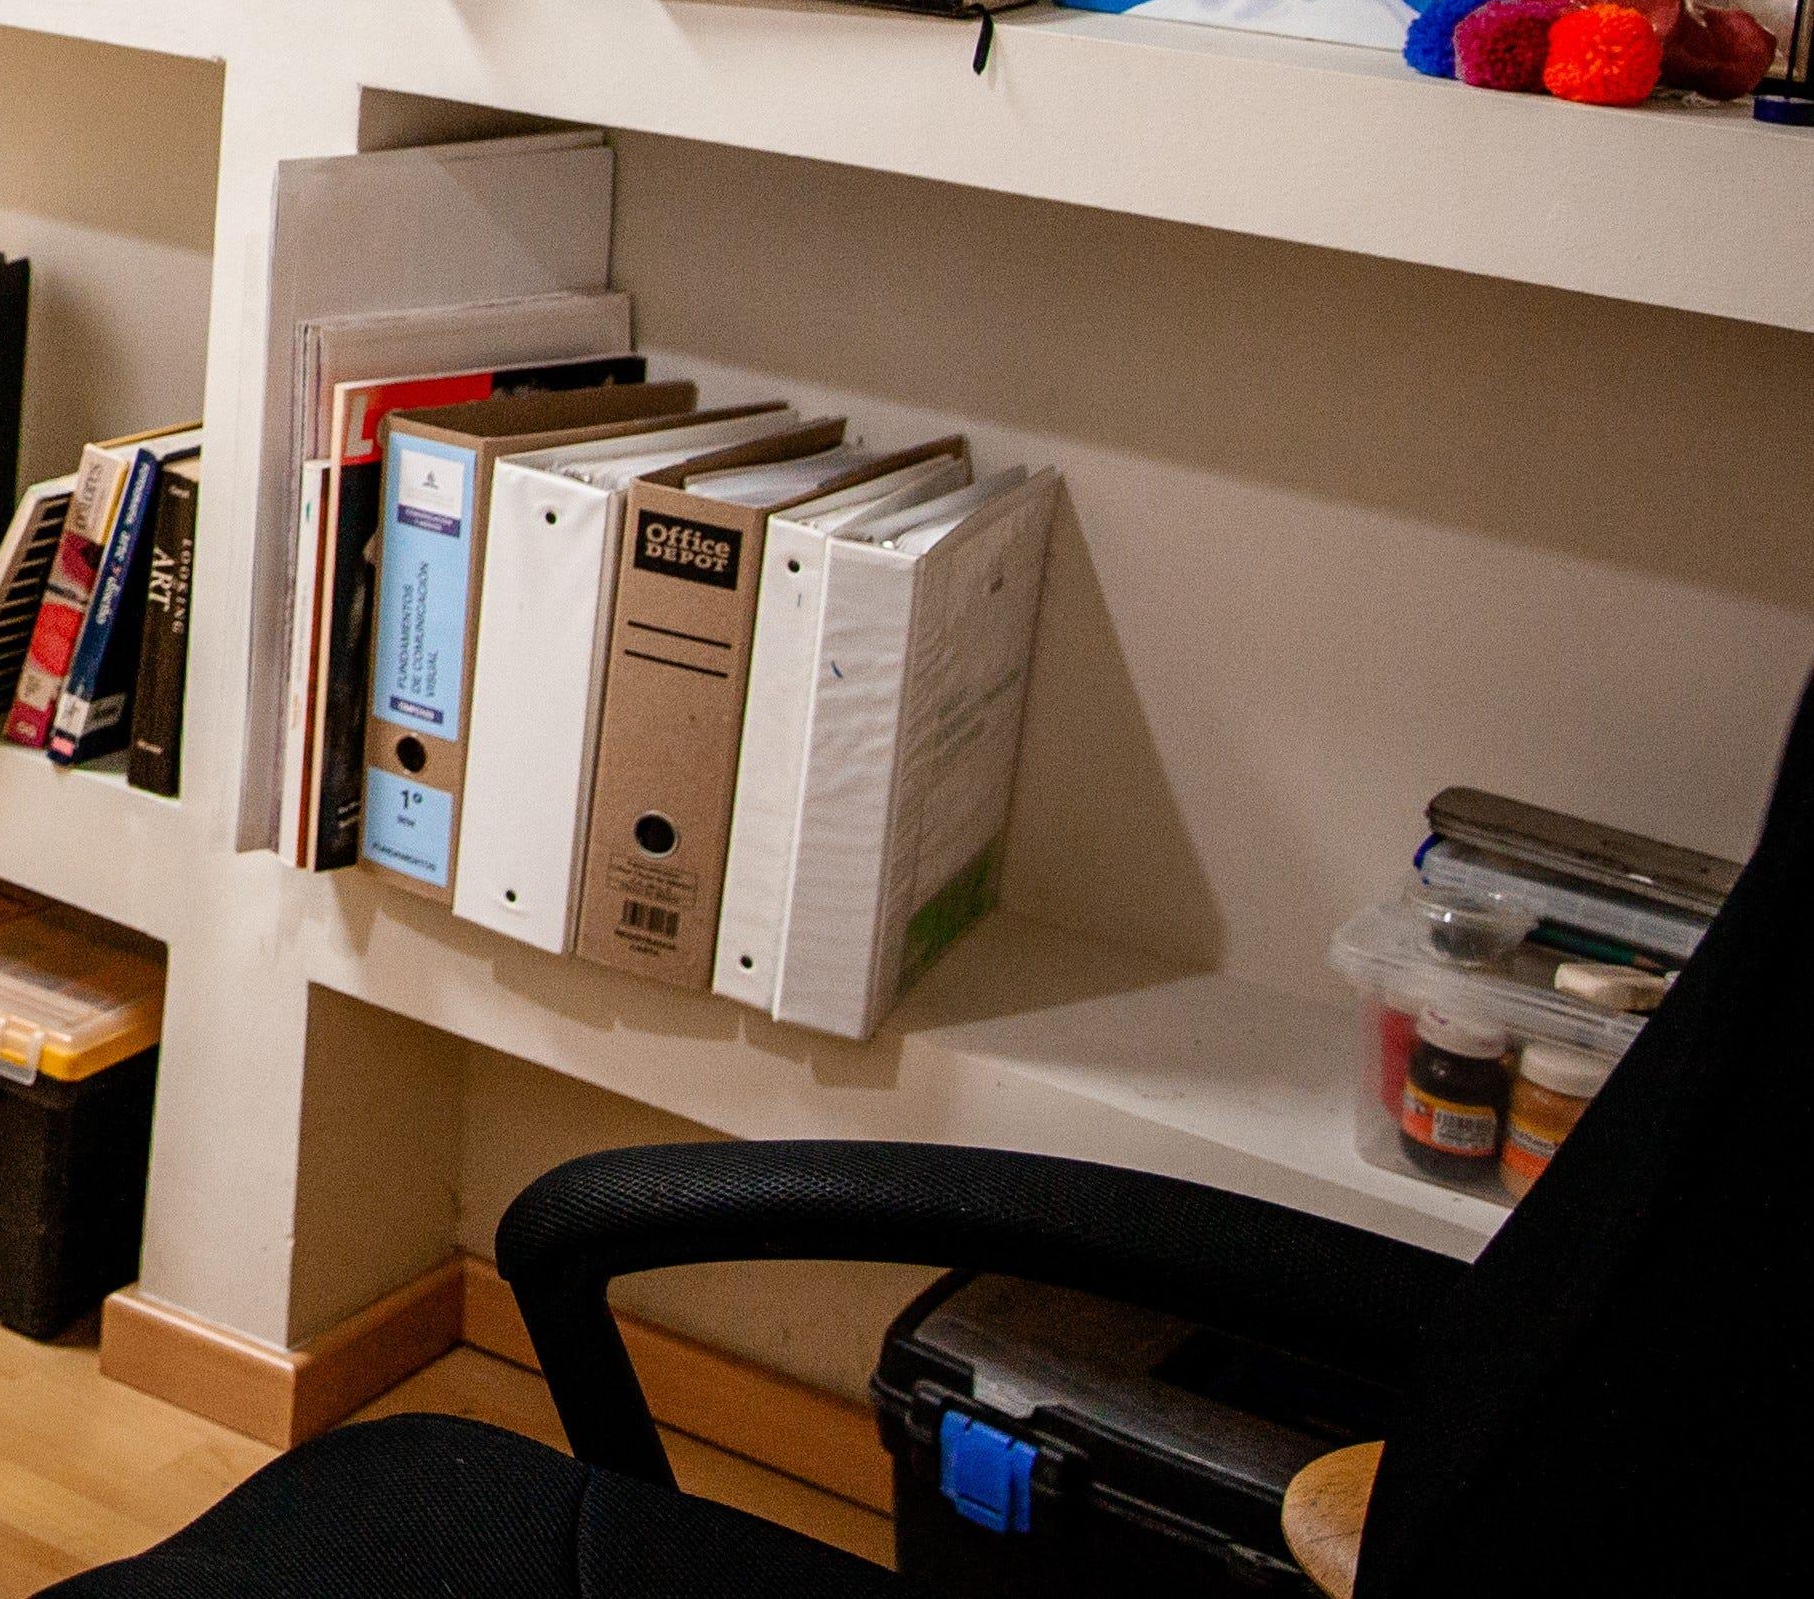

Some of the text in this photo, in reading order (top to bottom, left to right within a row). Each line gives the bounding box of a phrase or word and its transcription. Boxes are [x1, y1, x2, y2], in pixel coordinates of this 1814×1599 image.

[645, 523, 732, 559] Office
[645, 541, 729, 574] DEPOT
[148, 547, 176, 612] ART
[171, 537, 193, 634] LOOKING
